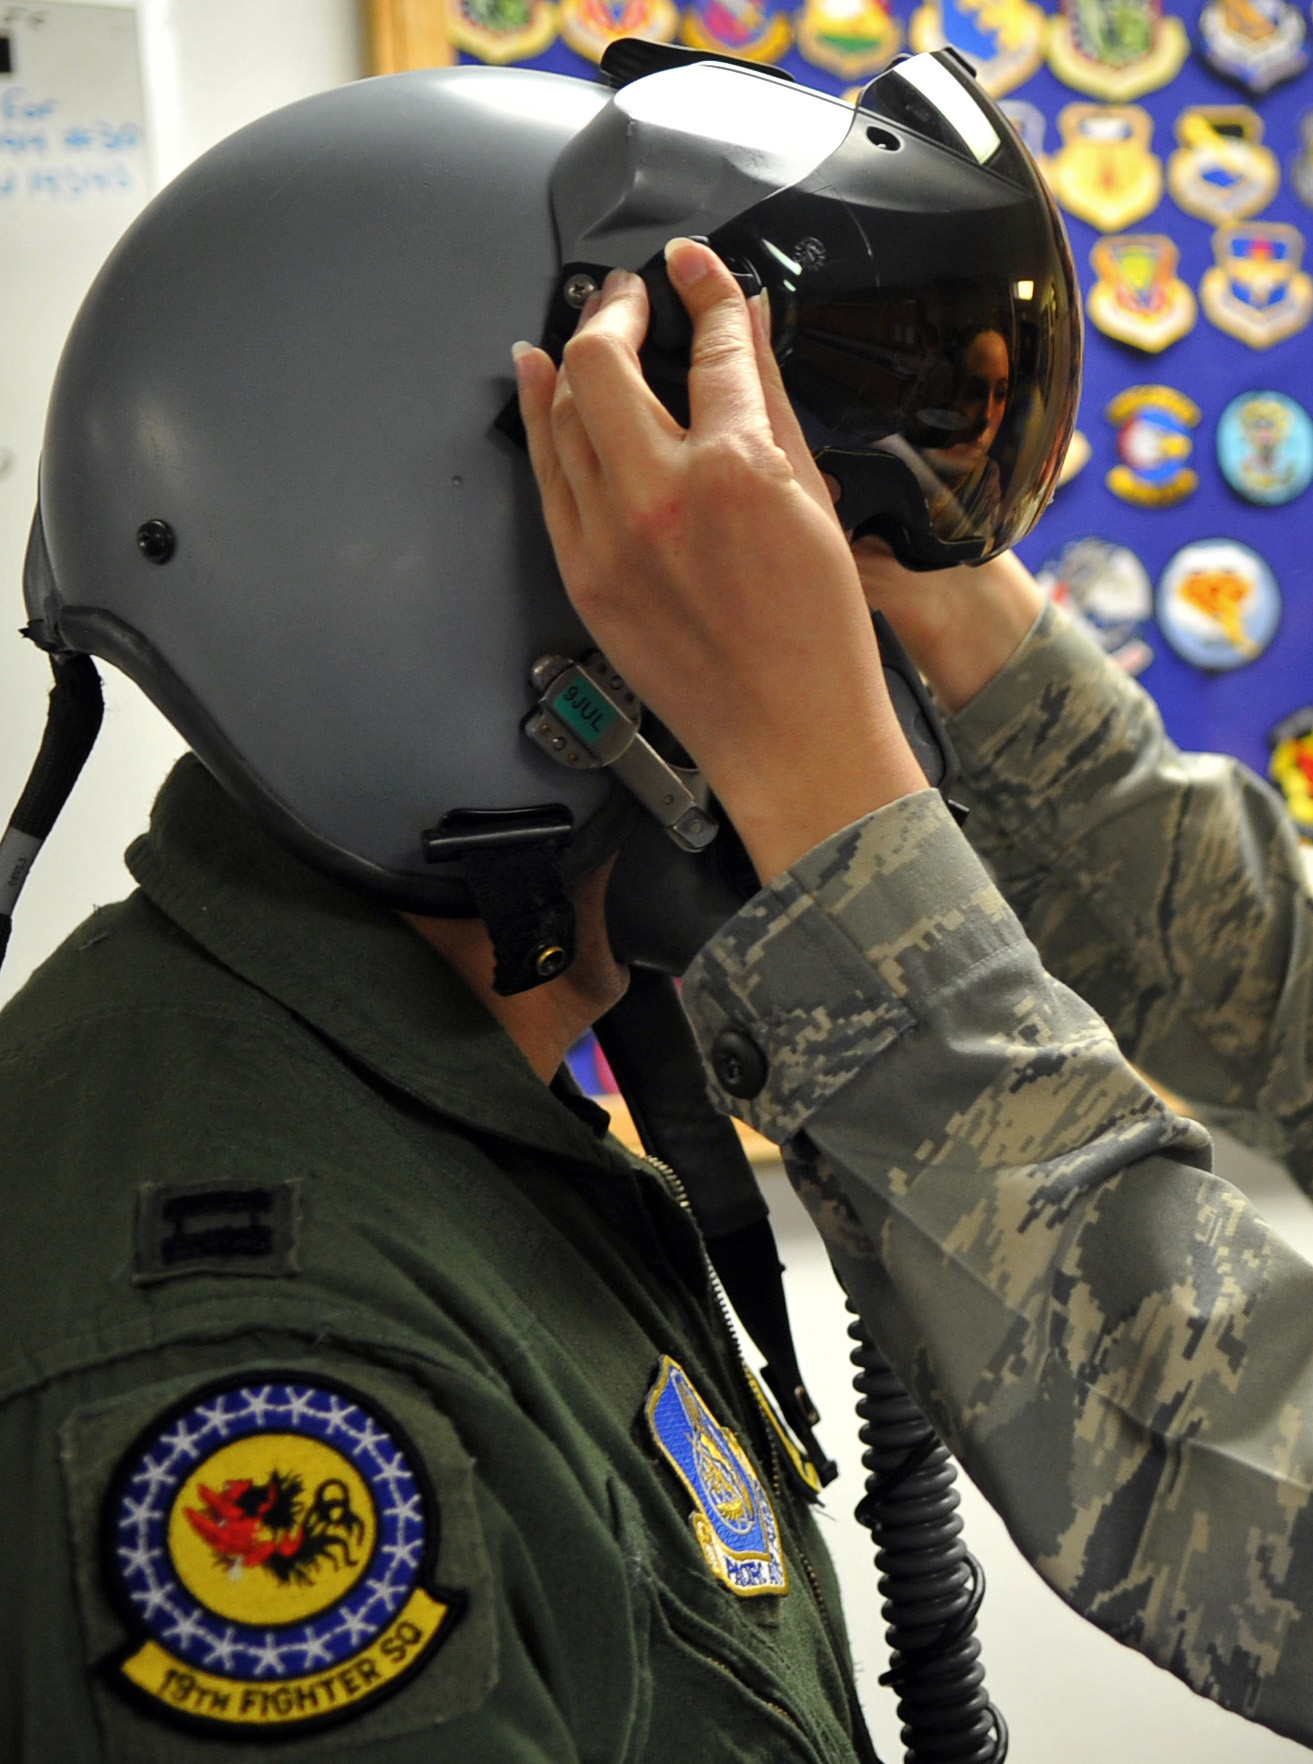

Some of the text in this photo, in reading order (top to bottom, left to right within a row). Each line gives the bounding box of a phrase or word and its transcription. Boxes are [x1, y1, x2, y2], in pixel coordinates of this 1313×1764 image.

[563, 685, 604, 732] 9JUL
[160, 1669, 231, 1712] 19TH
[238, 1657, 382, 1716] FIGHTER
